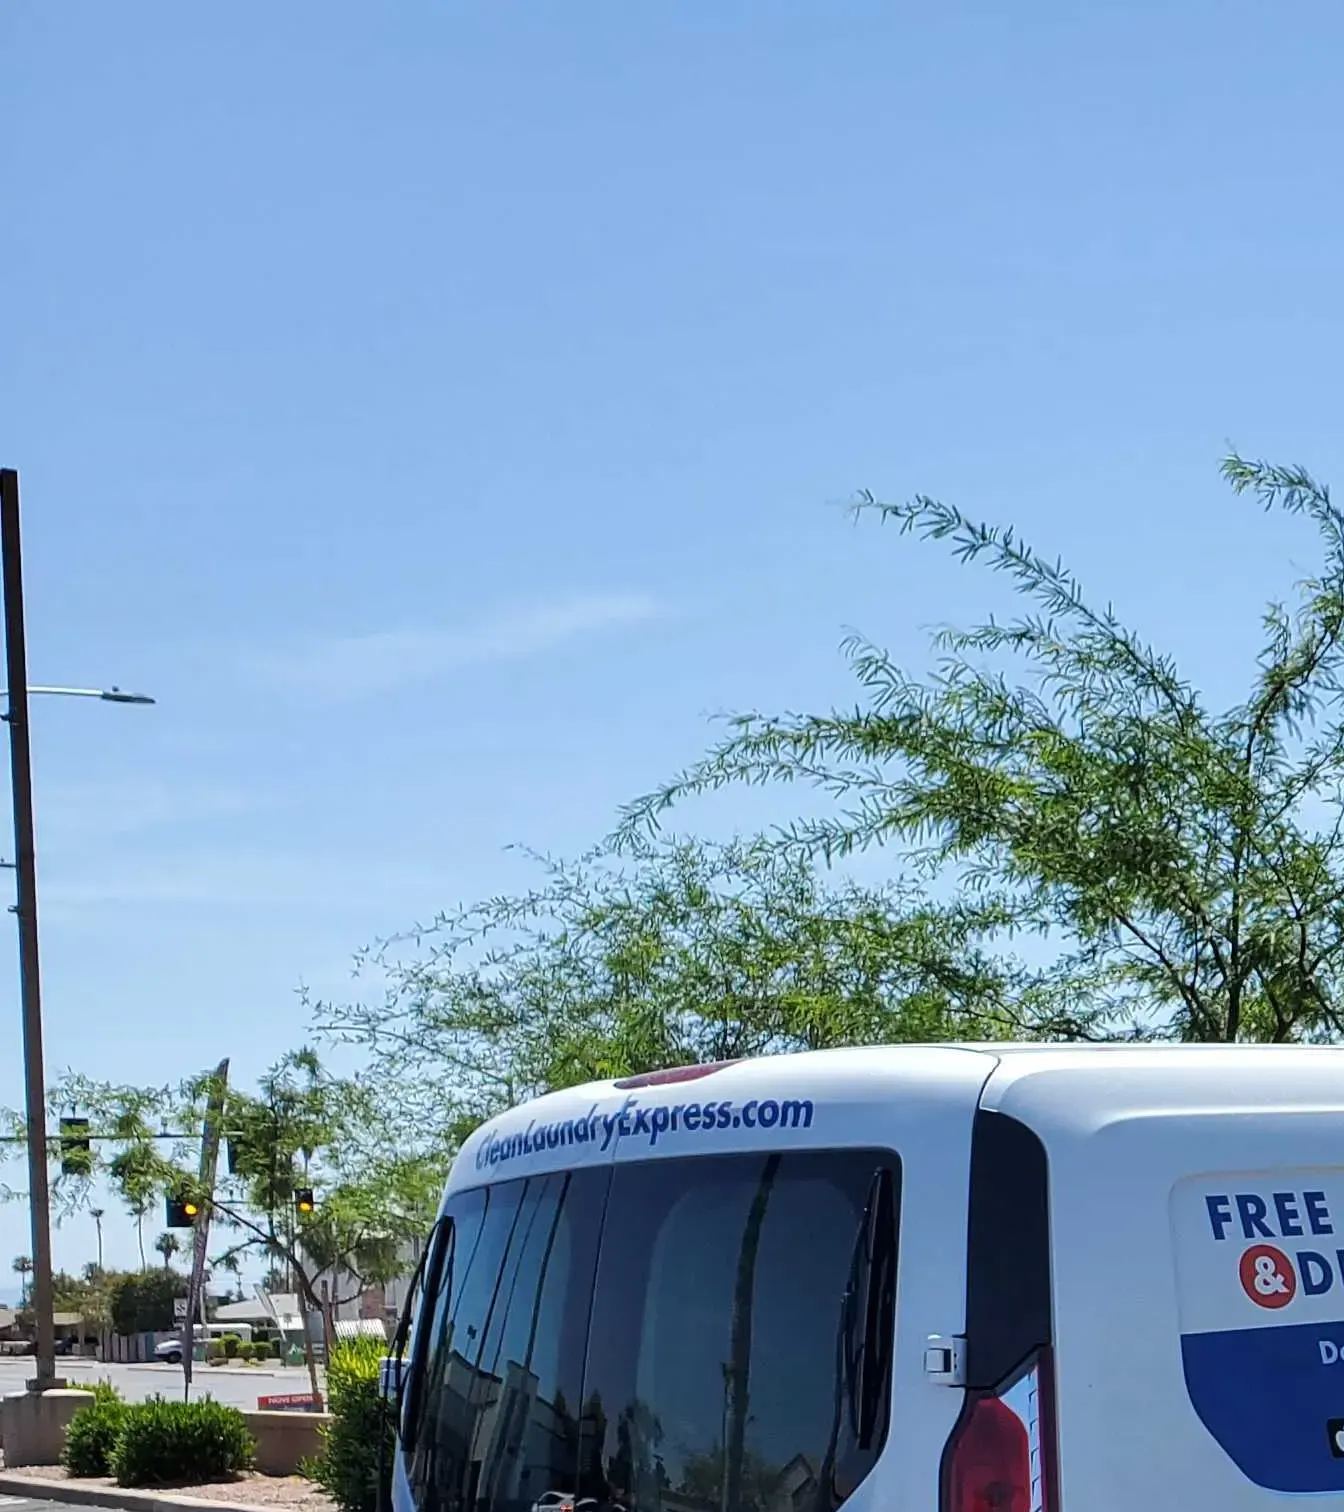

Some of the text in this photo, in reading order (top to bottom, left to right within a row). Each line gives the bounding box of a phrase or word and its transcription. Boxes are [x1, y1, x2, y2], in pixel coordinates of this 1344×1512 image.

[476, 1098, 814, 1171] CleanLaundryExpress.com
[1206, 1191, 1334, 1241] FREE
[1254, 1255, 1290, 1296] &
